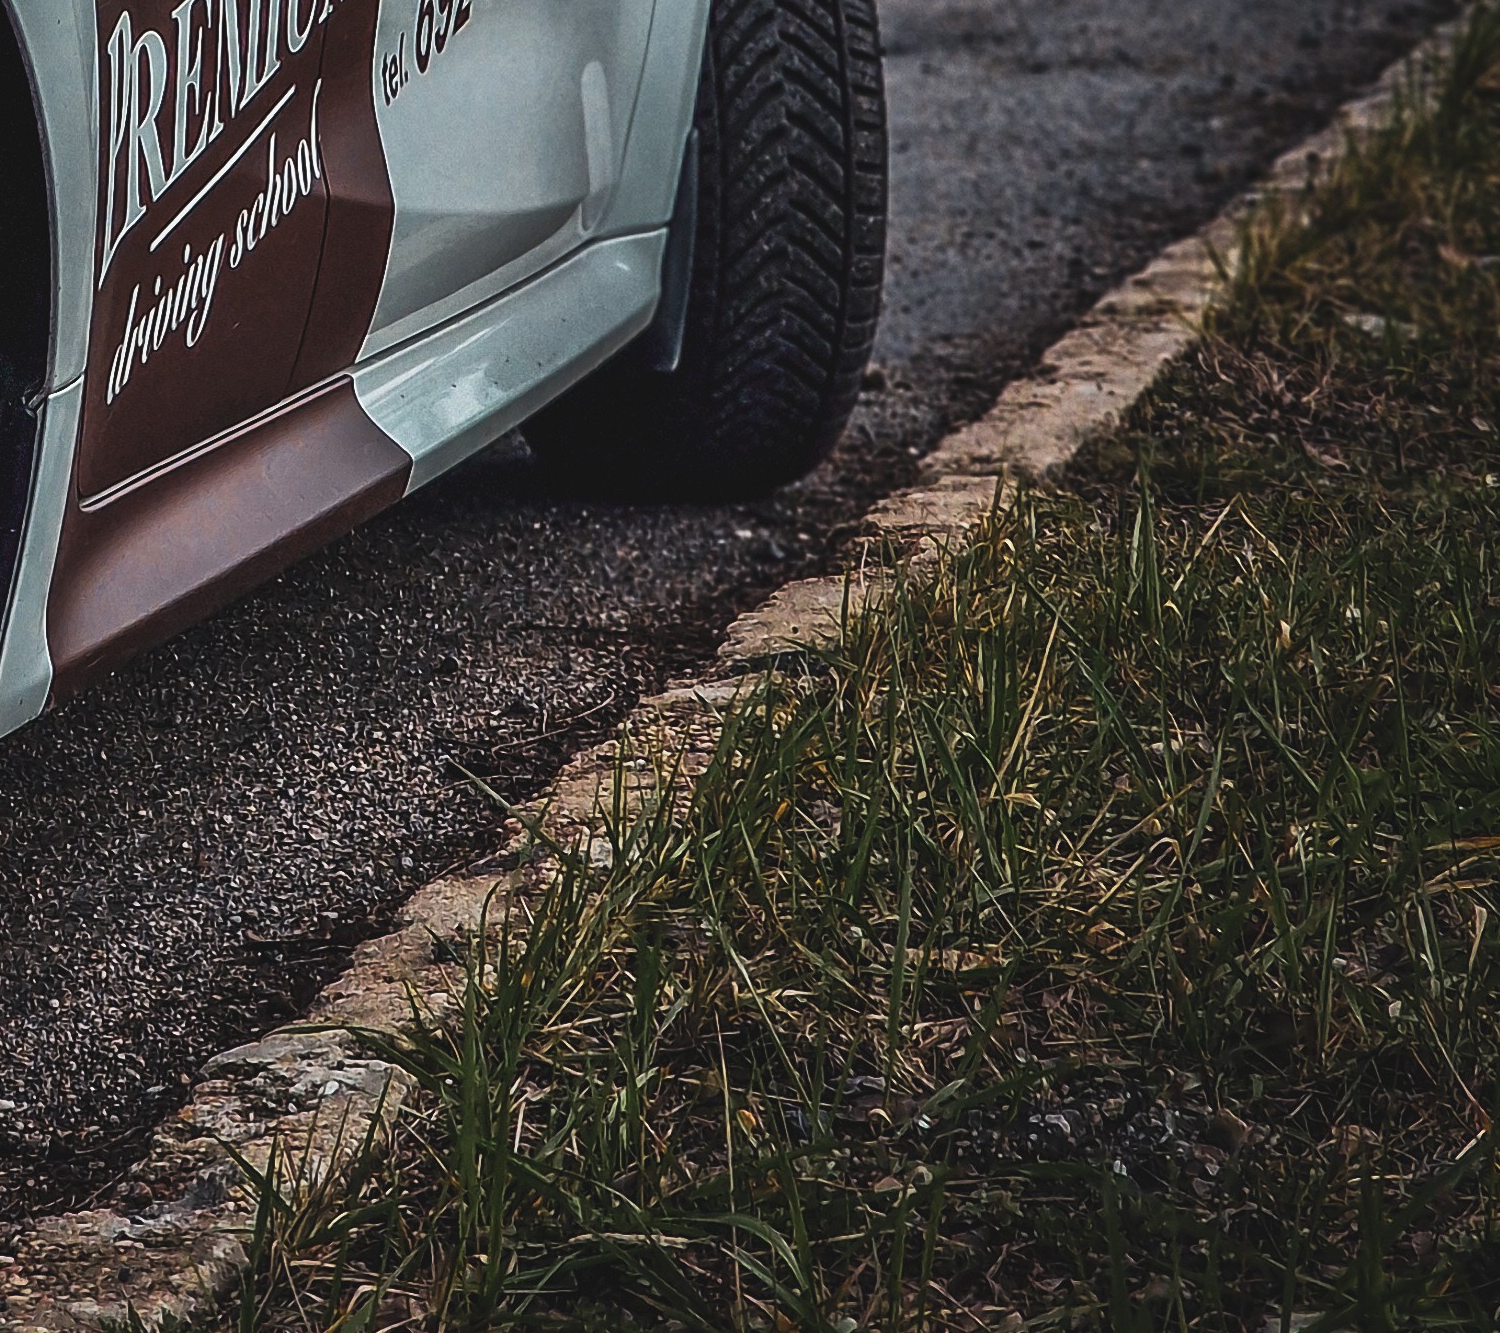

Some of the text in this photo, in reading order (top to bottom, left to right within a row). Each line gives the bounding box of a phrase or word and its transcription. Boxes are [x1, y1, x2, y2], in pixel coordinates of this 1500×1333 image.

[381, 31, 409, 107] tel.
[106, 78, 323, 405] driving school
